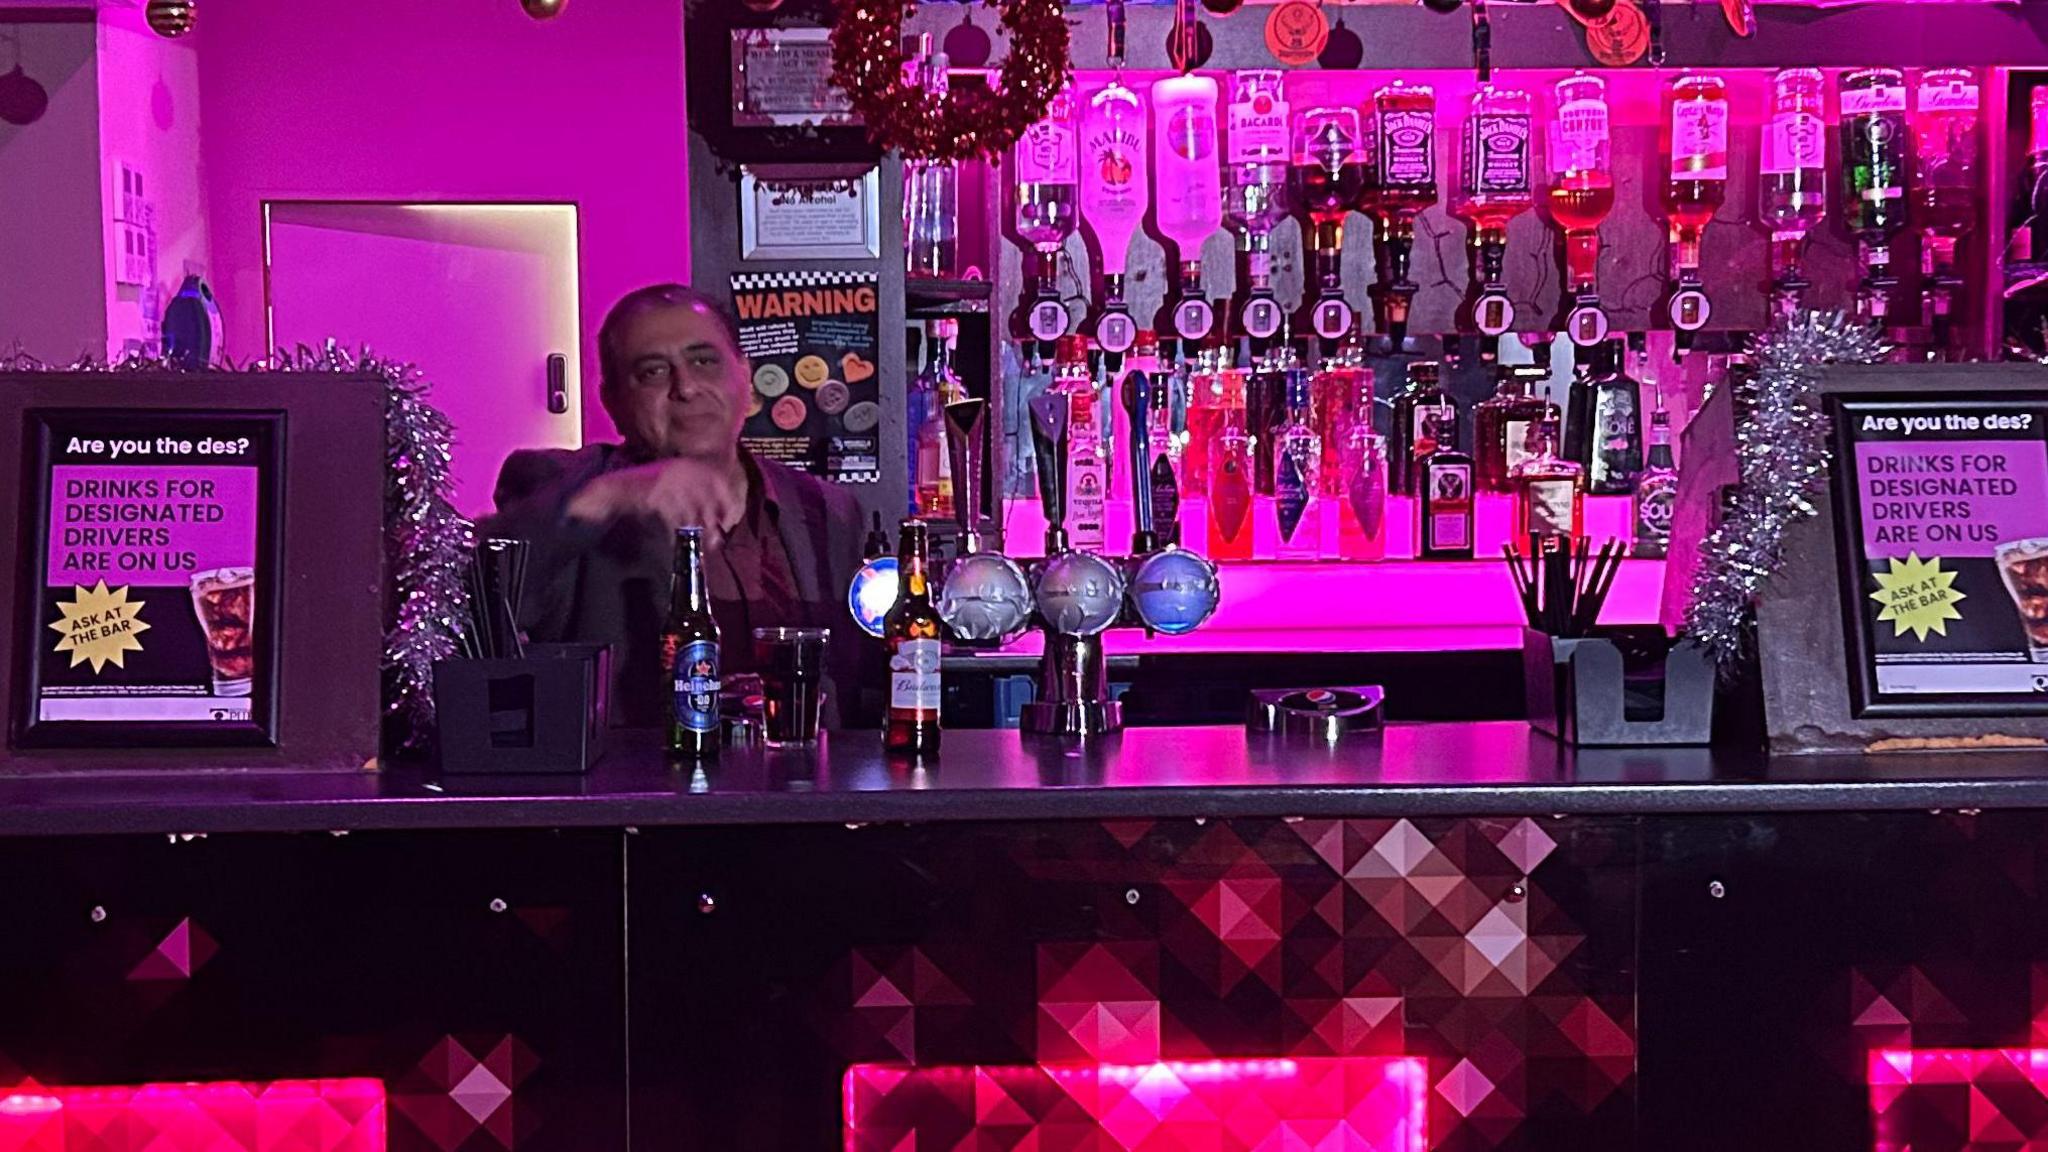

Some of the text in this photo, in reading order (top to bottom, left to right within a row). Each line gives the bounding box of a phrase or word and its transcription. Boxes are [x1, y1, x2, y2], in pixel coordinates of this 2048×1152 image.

[735, 287, 876, 319] WARNING
[1862, 414, 2032, 435] Are you the des?
[66, 437, 250, 459] Are you the des?
[1867, 455, 2007, 474] DRINKS FOR
[66, 479, 216, 498] DRINKS FOR
[1870, 478, 2018, 497] DESIGNATED
[65, 503, 224, 522] DESIGNATED
[1640, 502, 1674, 520] SOU
[1872, 501, 1971, 520] DRIVERS
[64, 528, 170, 546] DRIVERS
[1875, 524, 1999, 543] ARE ON US
[63, 551, 197, 571] ARE ON US
[1891, 576, 1937, 602] ASK AT
[1890, 589, 1948, 615] THE BAR
[72, 606, 122, 632] ASK AT
[69, 619, 132, 646] THE BAR
